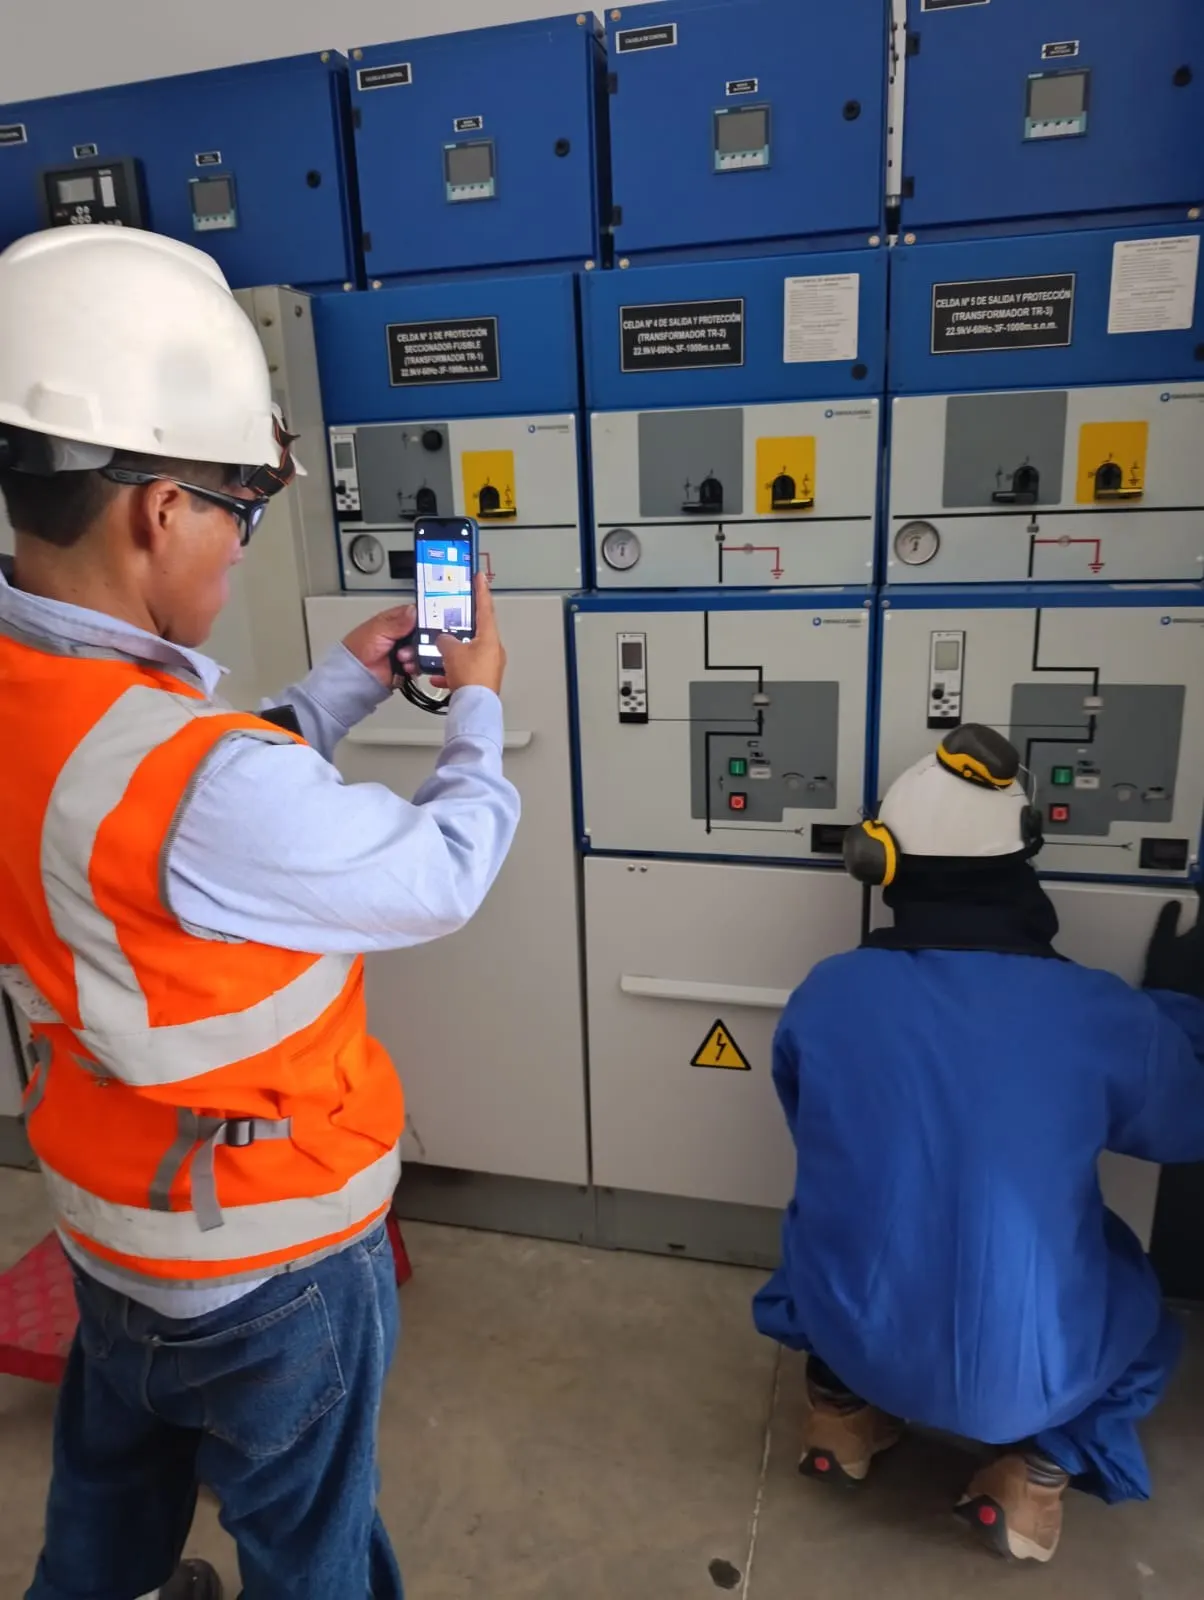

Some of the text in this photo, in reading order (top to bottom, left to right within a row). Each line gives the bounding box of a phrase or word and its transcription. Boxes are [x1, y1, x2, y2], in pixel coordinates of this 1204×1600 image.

[936, 297, 960, 308] CELDA
[976, 295, 987, 306] DE
[988, 293, 1016, 305] SALIDA
[1016, 293, 1022, 303] Y
[1022, 288, 1071, 302] PROTECCIÓN
[623, 320, 645, 330] CELDA
[658, 318, 668, 327] DE
[669, 316, 692, 327] SALIDA
[692, 315, 697, 325] Y
[951, 307, 1030, 323] (TRANSFORMADOR
[396, 333, 419, 343] CELDA
[433, 331, 442, 340] DE
